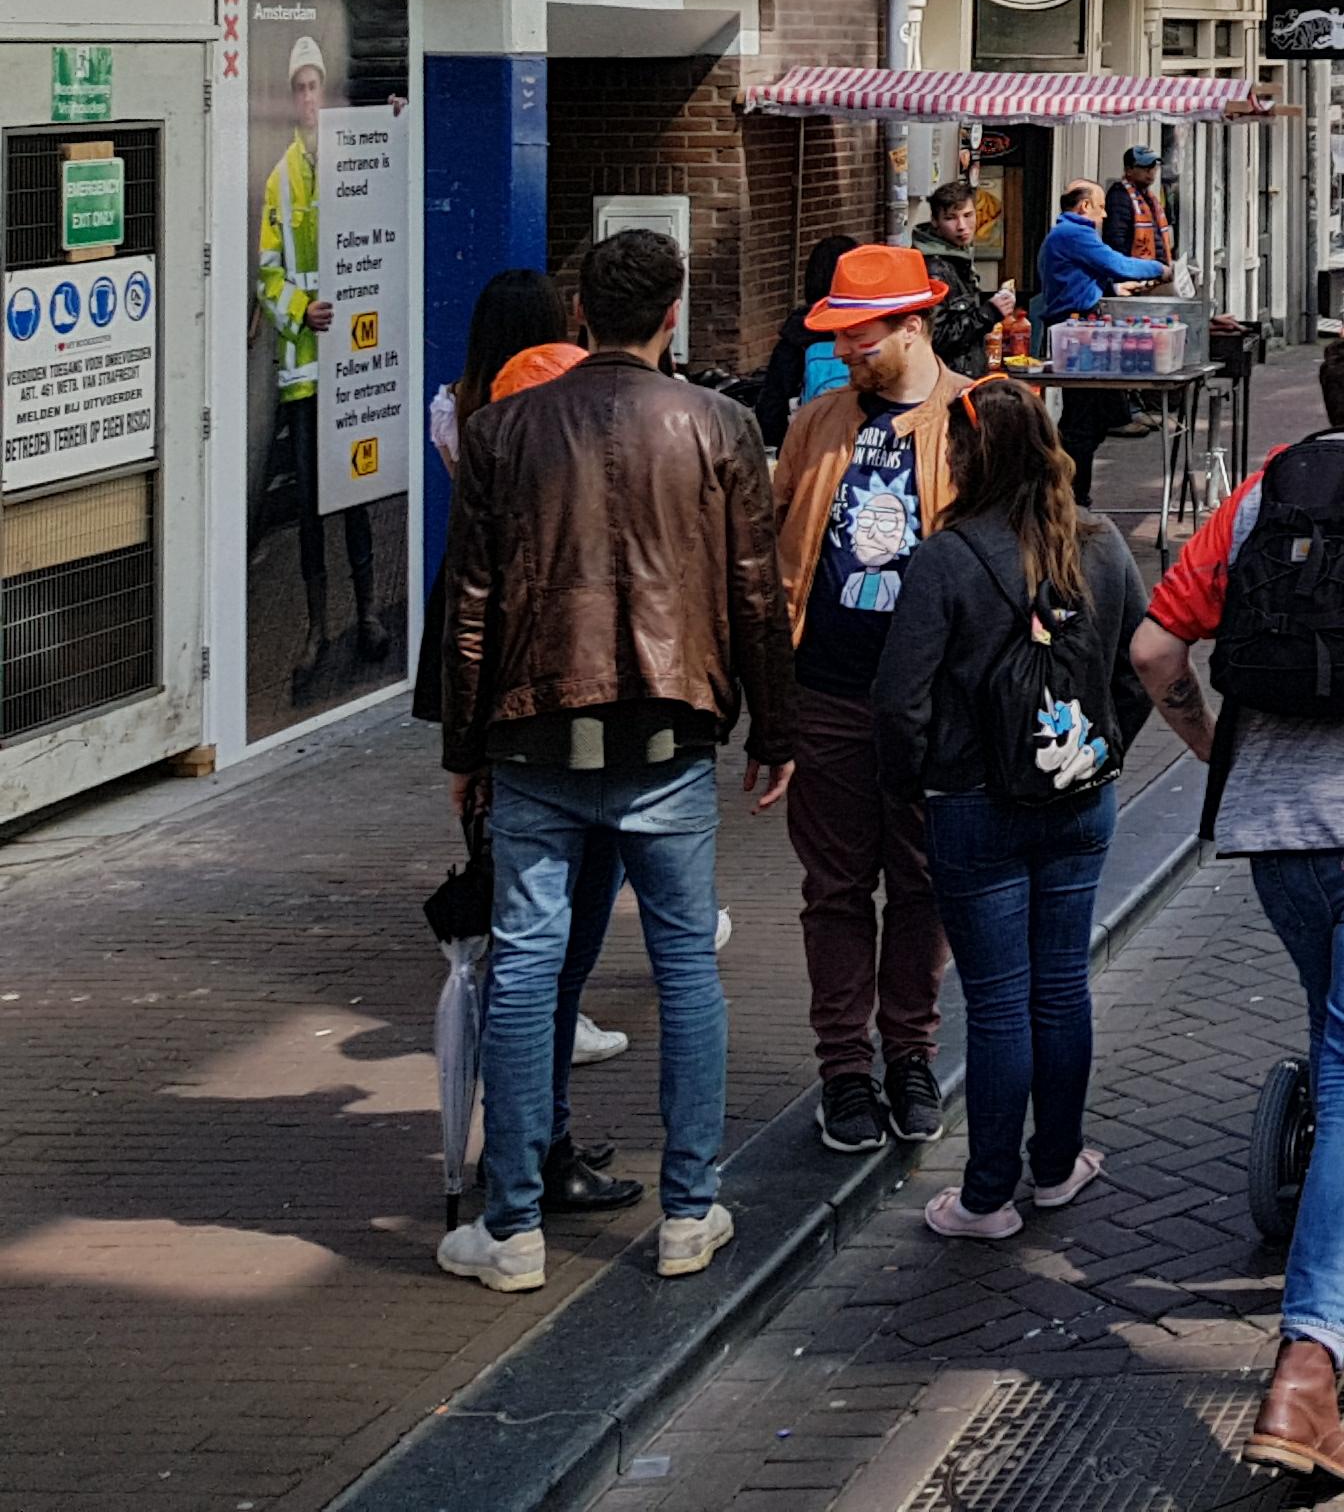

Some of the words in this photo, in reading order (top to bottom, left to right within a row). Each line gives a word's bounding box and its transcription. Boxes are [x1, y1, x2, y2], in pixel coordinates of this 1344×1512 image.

[252, 2, 317, 21] Amsterdam
[335, 130, 357, 147] This
[358, 131, 390, 146] metro
[335, 157, 380, 173] entrance
[381, 153, 390, 169] is
[335, 179, 369, 198] closed
[335, 231, 370, 250] Follow
[372, 228, 383, 245] M
[384, 229, 396, 243] to
[335, 257, 353, 276] the
[355, 254, 383, 273] other
[335, 283, 380, 302] entrance
[360, 319, 375, 342] M
[335, 358, 370, 379] Follow
[372, 354, 383, 371] M
[384, 350, 399, 368] lift
[335, 386, 351, 405] for
[353, 379, 397, 400] entrance
[16, 405, 62, 425] MELDEN
[64, 400, 81, 416] BIJ
[335, 409, 359, 430] with
[360, 402, 402, 424] elevator
[5, 431, 52, 463] BETREDEN
[53, 422, 88, 453] TERREIN
[90, 419, 101, 444] OP
